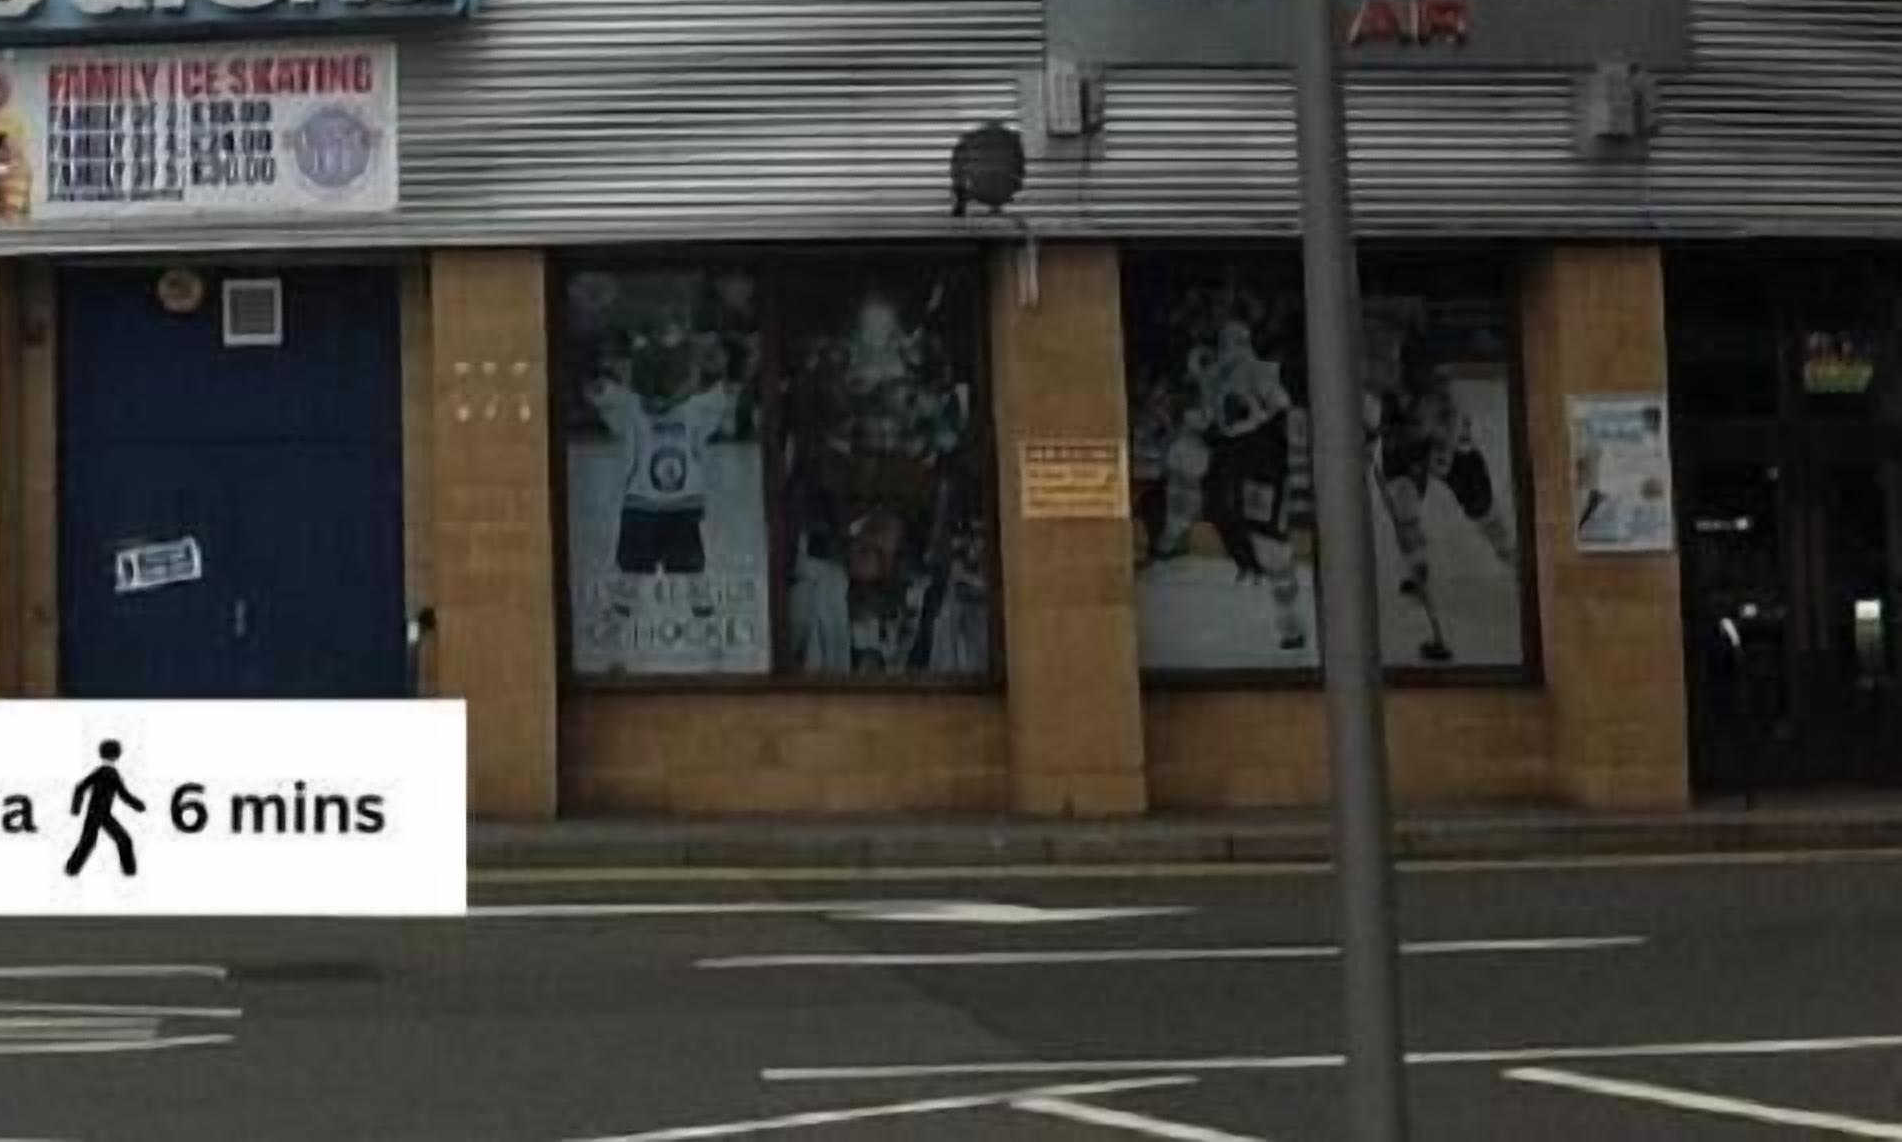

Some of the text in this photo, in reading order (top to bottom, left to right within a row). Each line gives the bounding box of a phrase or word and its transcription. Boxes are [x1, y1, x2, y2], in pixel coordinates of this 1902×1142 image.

[49, 53, 373, 101] FAMILY ICE SKATING
